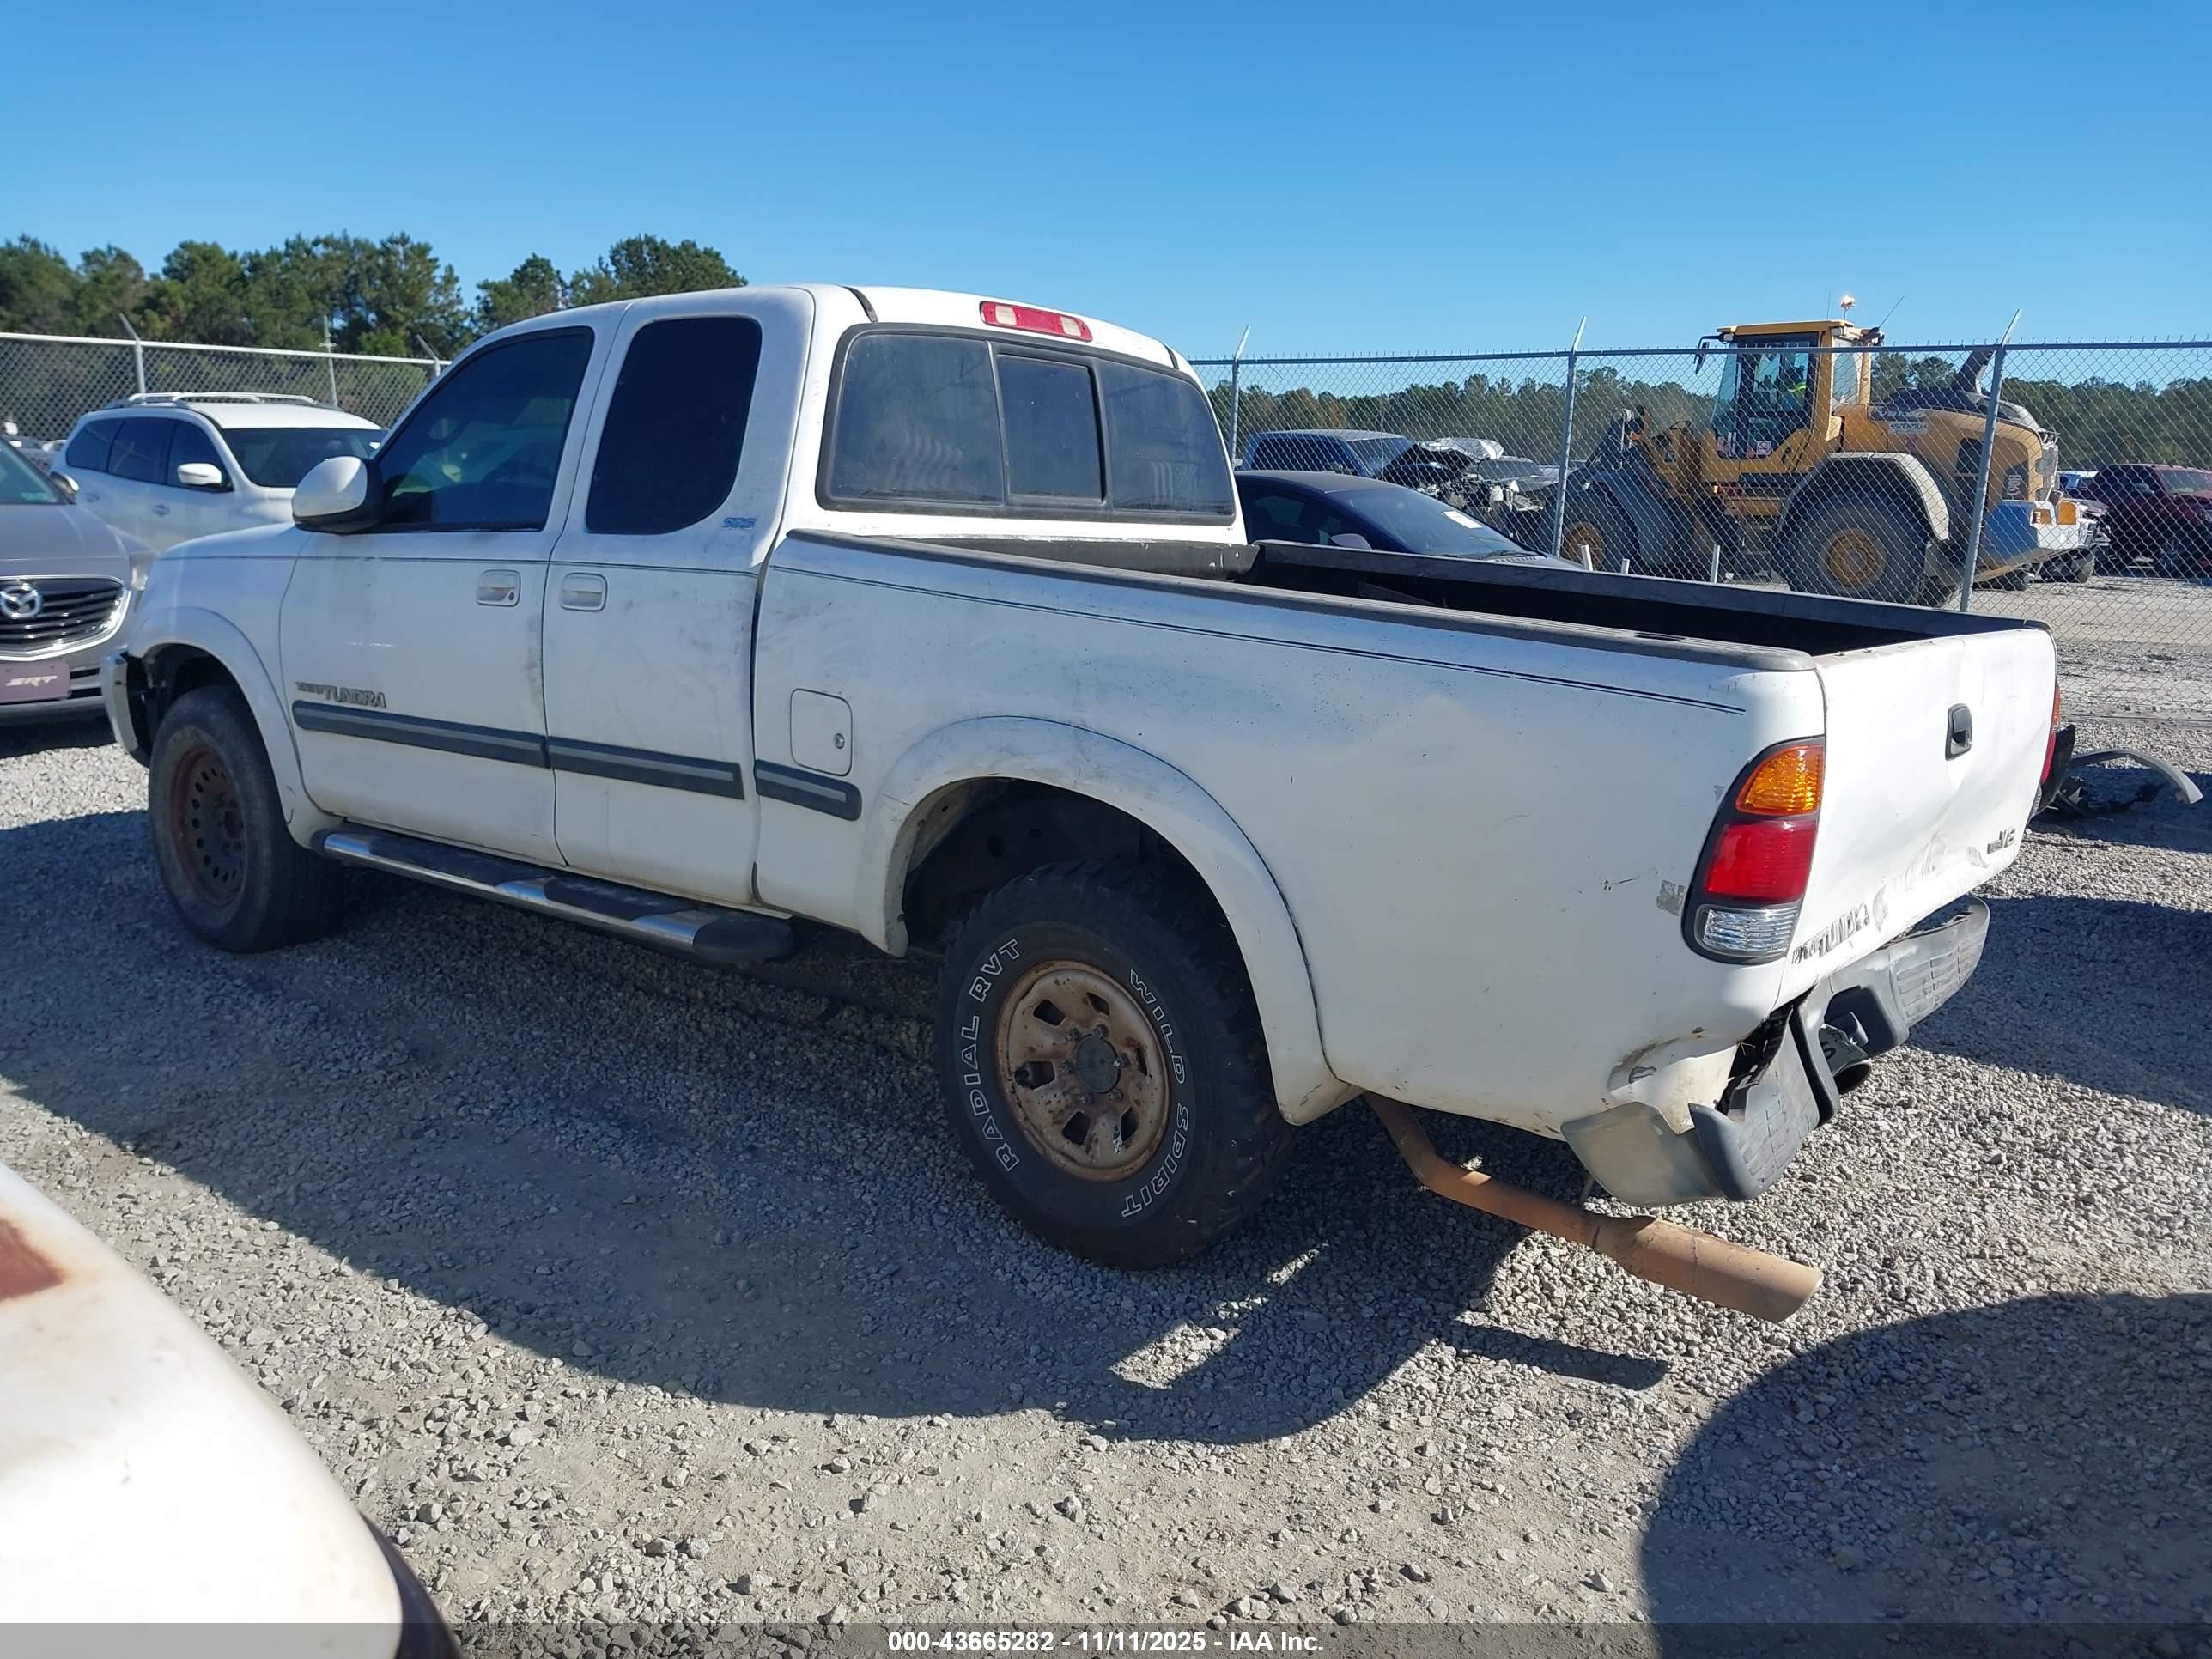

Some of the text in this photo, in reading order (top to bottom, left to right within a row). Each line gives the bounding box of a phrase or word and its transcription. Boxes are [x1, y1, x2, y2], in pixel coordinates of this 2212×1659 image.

[5, 675, 58, 687] SRT
[325, 686, 386, 708] TUNDRA
[961, 939, 1021, 1171] RADIAL RVT
[1121, 969, 1189, 1218] WILD SPIRIT
